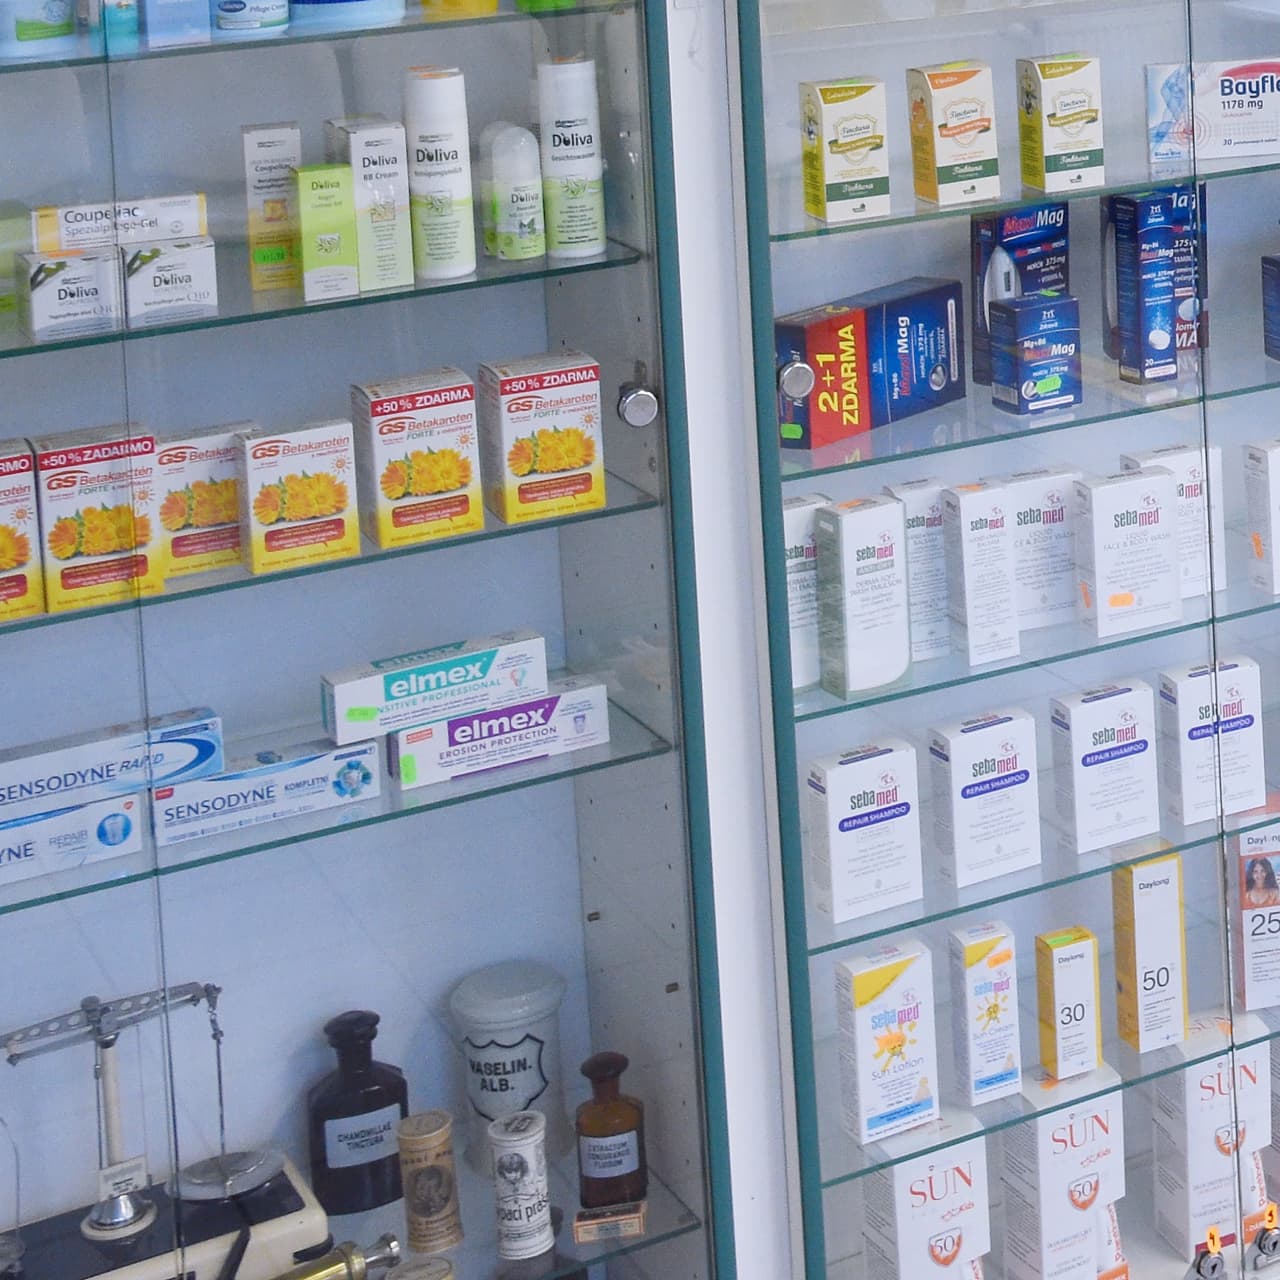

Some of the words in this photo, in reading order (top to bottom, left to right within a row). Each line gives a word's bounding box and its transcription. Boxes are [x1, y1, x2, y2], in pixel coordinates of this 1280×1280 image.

[1221, 99, 1243, 109] 1178
[1247, 100, 1263, 111] mg
[504, 381, 526, 392] +50
[528, 379, 539, 388] %
[543, 370, 596, 387] ZDARMA
[818, 352, 838, 414] 2+1
[843, 324, 860, 425] ZDARMA
[376, 402, 398, 414] +50
[400, 399, 413, 410] %
[416, 388, 471, 406] ZDARMA
[535, 393, 597, 410] Betakaroten
[408, 412, 472, 430] Betakaroten
[282, 436, 349, 455] Betakaroten
[42, 455, 68, 468] +50
[391, 662, 482, 697] elmex
[422, 680, 501, 703] PROFESSIONAL
[454, 708, 546, 743] elmex
[1092, 723, 1138, 745] sebamed
[439, 743, 486, 760] EROSION
[491, 727, 556, 749] PROTECTION
[1086, 752, 1109, 765] REPAIR
[1110, 743, 1145, 759] SHAMPOO
[972, 755, 1018, 778] sebamed
[0, 764, 115, 802] SENSODYNE
[967, 783, 989, 796] REPAIR
[990, 773, 1026, 790] SHAMPOO
[165, 786, 275, 821] SENSODYNE
[850, 786, 898, 810] sebamed
[1143, 968, 1169, 992] 50
[1061, 1004, 1085, 1025] 30
[469, 1057, 533, 1076] VASELIN.
[480, 1078, 514, 1092] ALB.
[1052, 1110, 1110, 1155] SUN
[910, 1161, 973, 1208] SUN
[1073, 1180, 1093, 1198] 50
